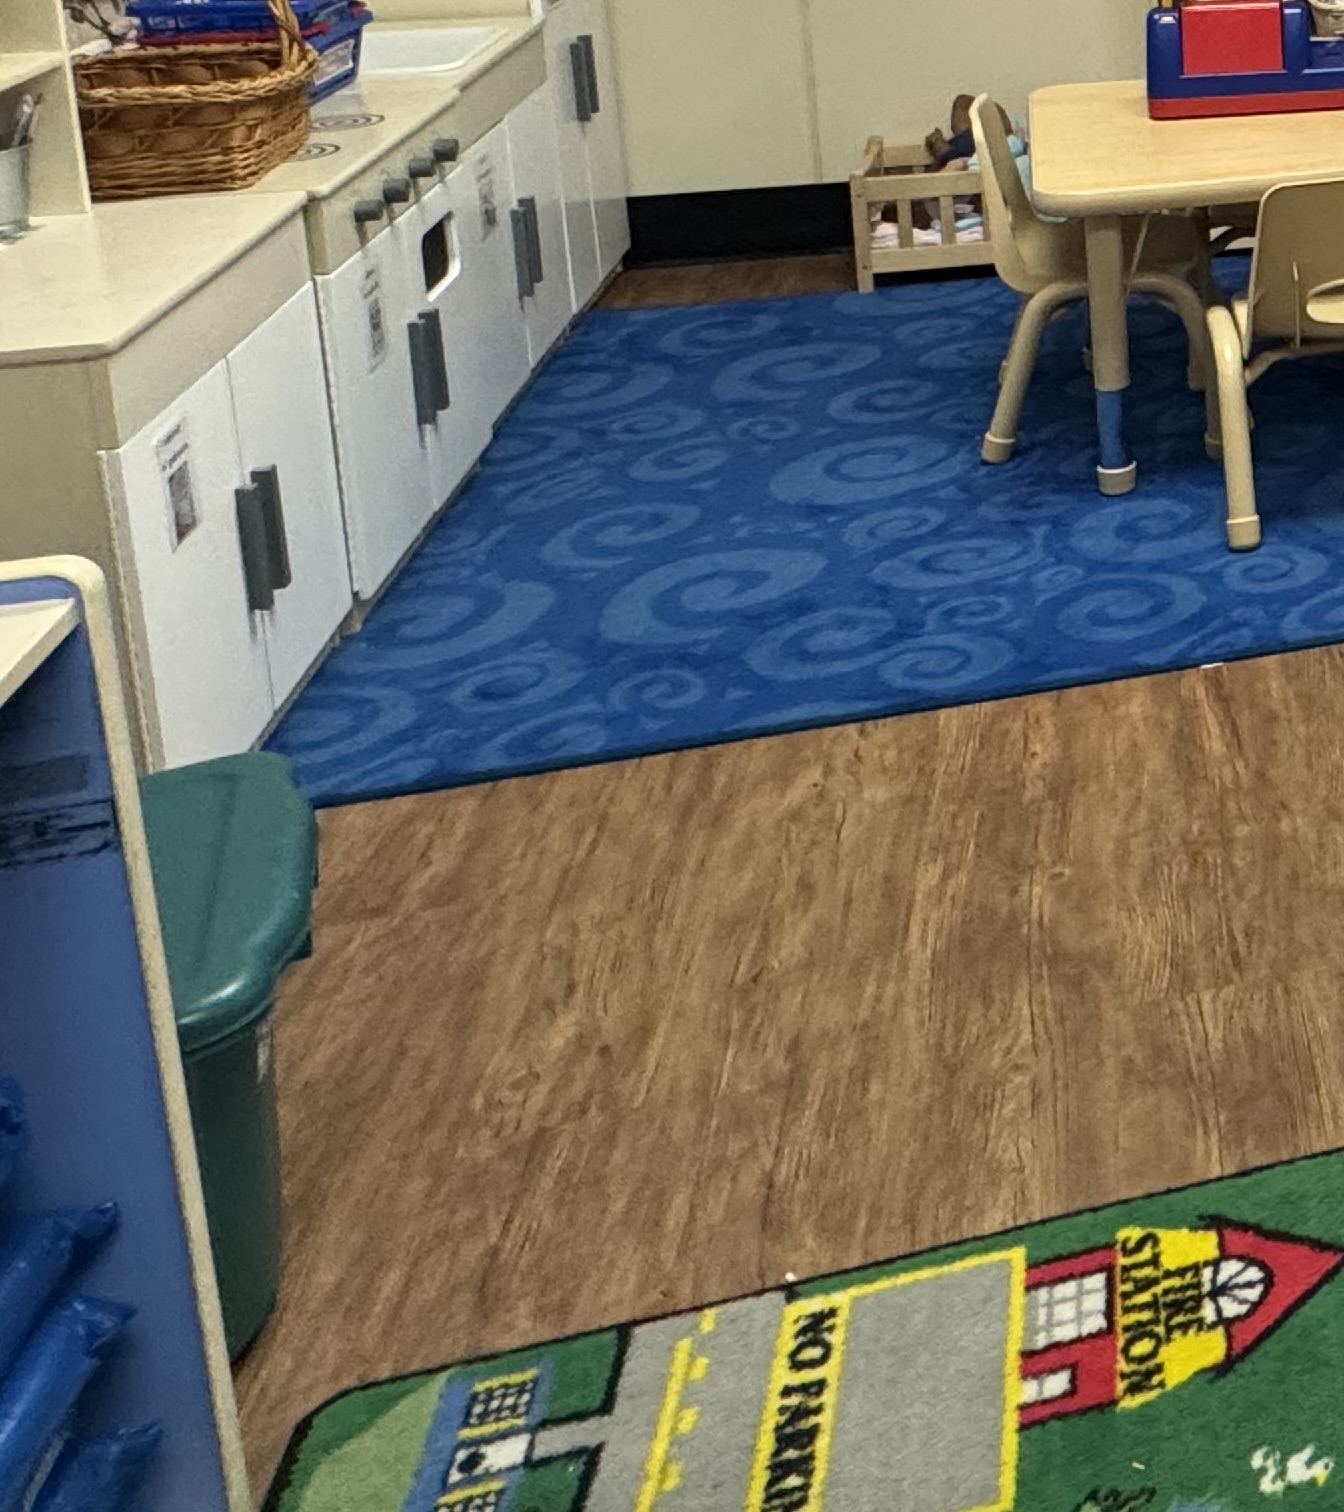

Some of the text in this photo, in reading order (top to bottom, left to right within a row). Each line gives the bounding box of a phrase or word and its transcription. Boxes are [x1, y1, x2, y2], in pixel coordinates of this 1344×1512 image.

[789, 1307, 838, 1370] NO
[1118, 1232, 1166, 1397] STATION
[1161, 1261, 1205, 1342] FIRE
